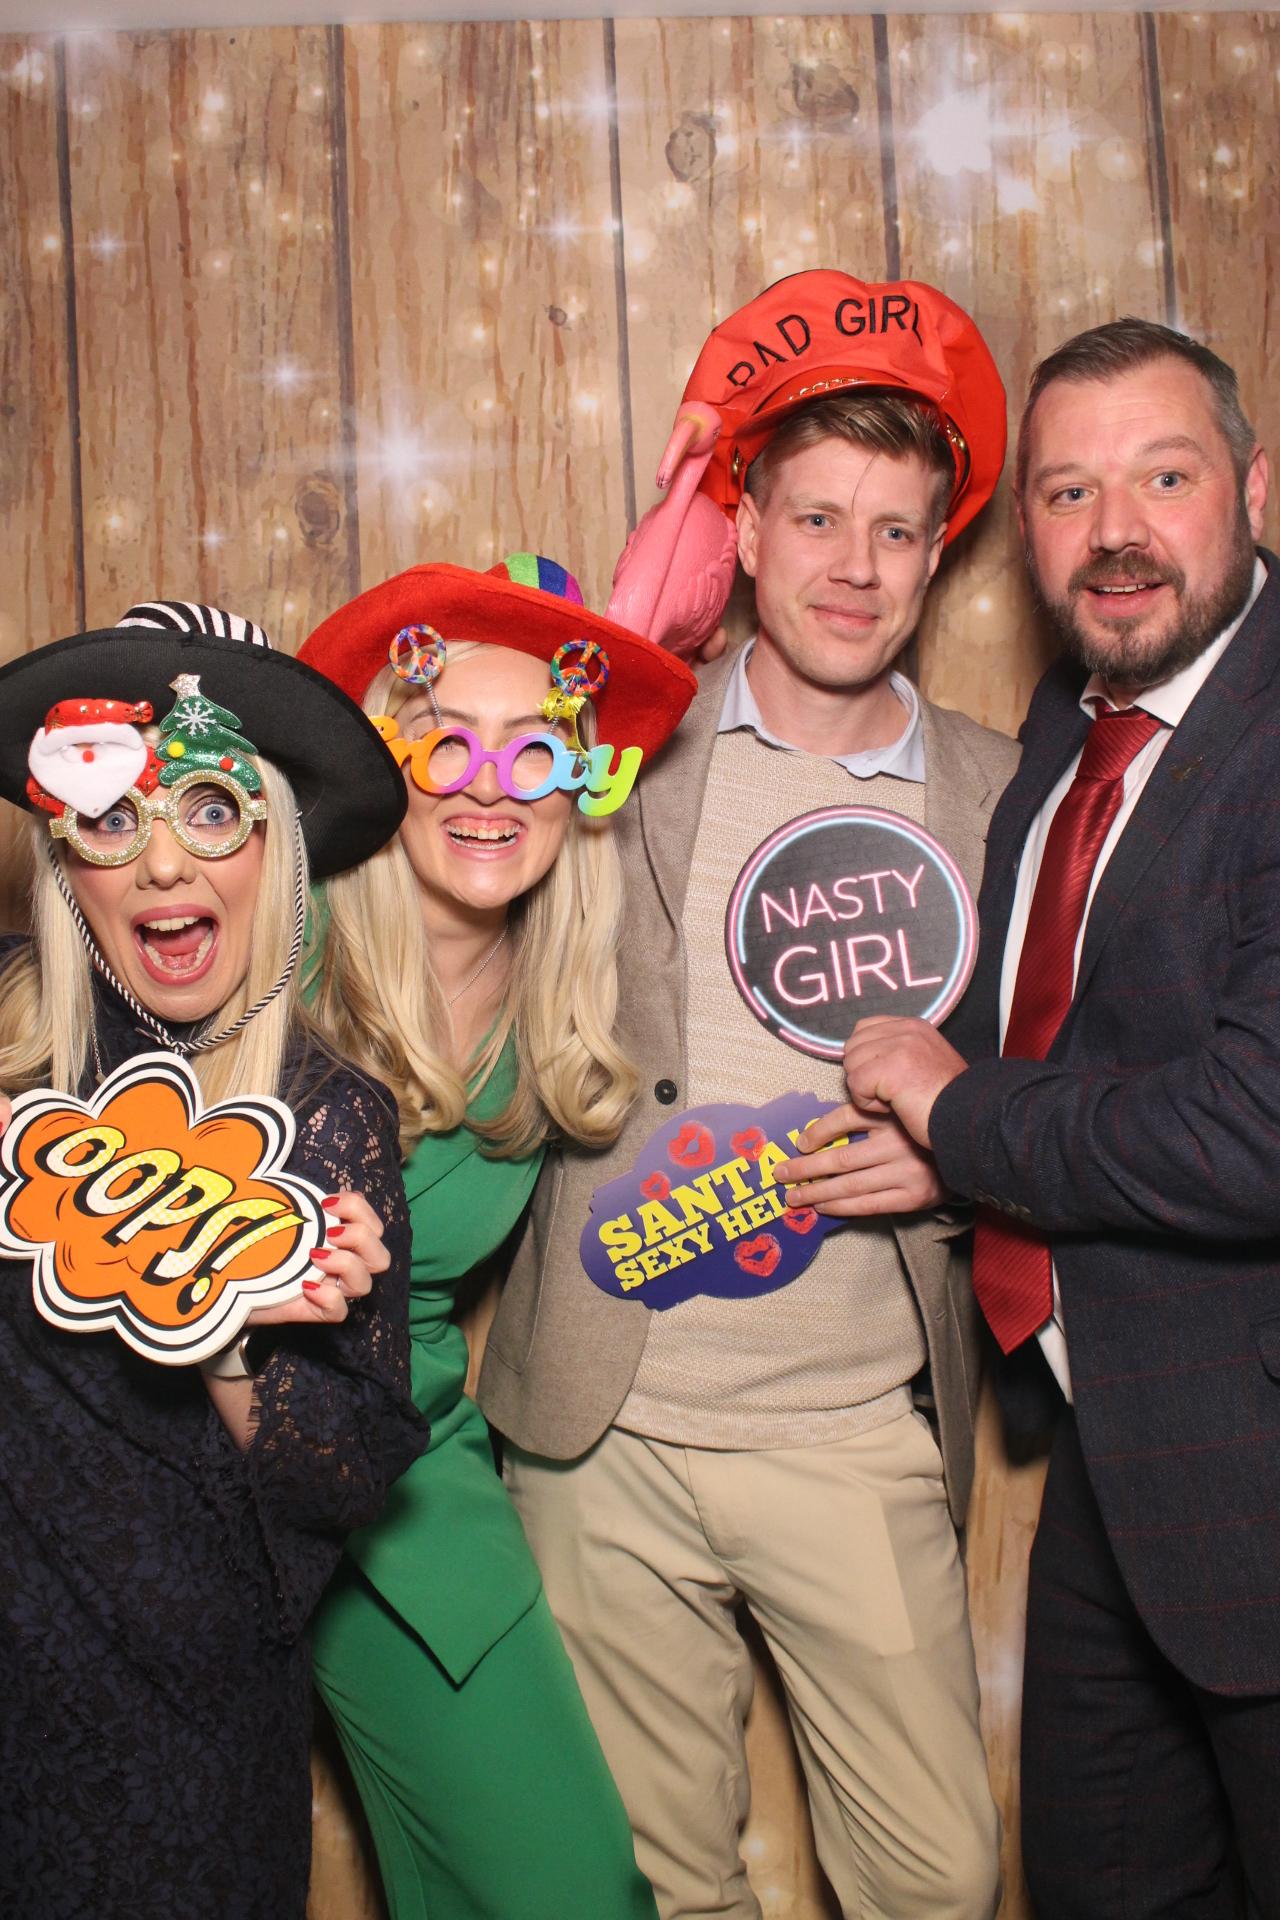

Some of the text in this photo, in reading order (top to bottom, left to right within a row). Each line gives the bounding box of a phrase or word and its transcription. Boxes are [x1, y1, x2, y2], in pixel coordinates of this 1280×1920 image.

[761, 864, 925, 934] NASTY
[773, 928, 944, 1006] GIRL
[34, 1125, 311, 1316] OOPS!
[614, 1180, 822, 1292] SEXY HEL
